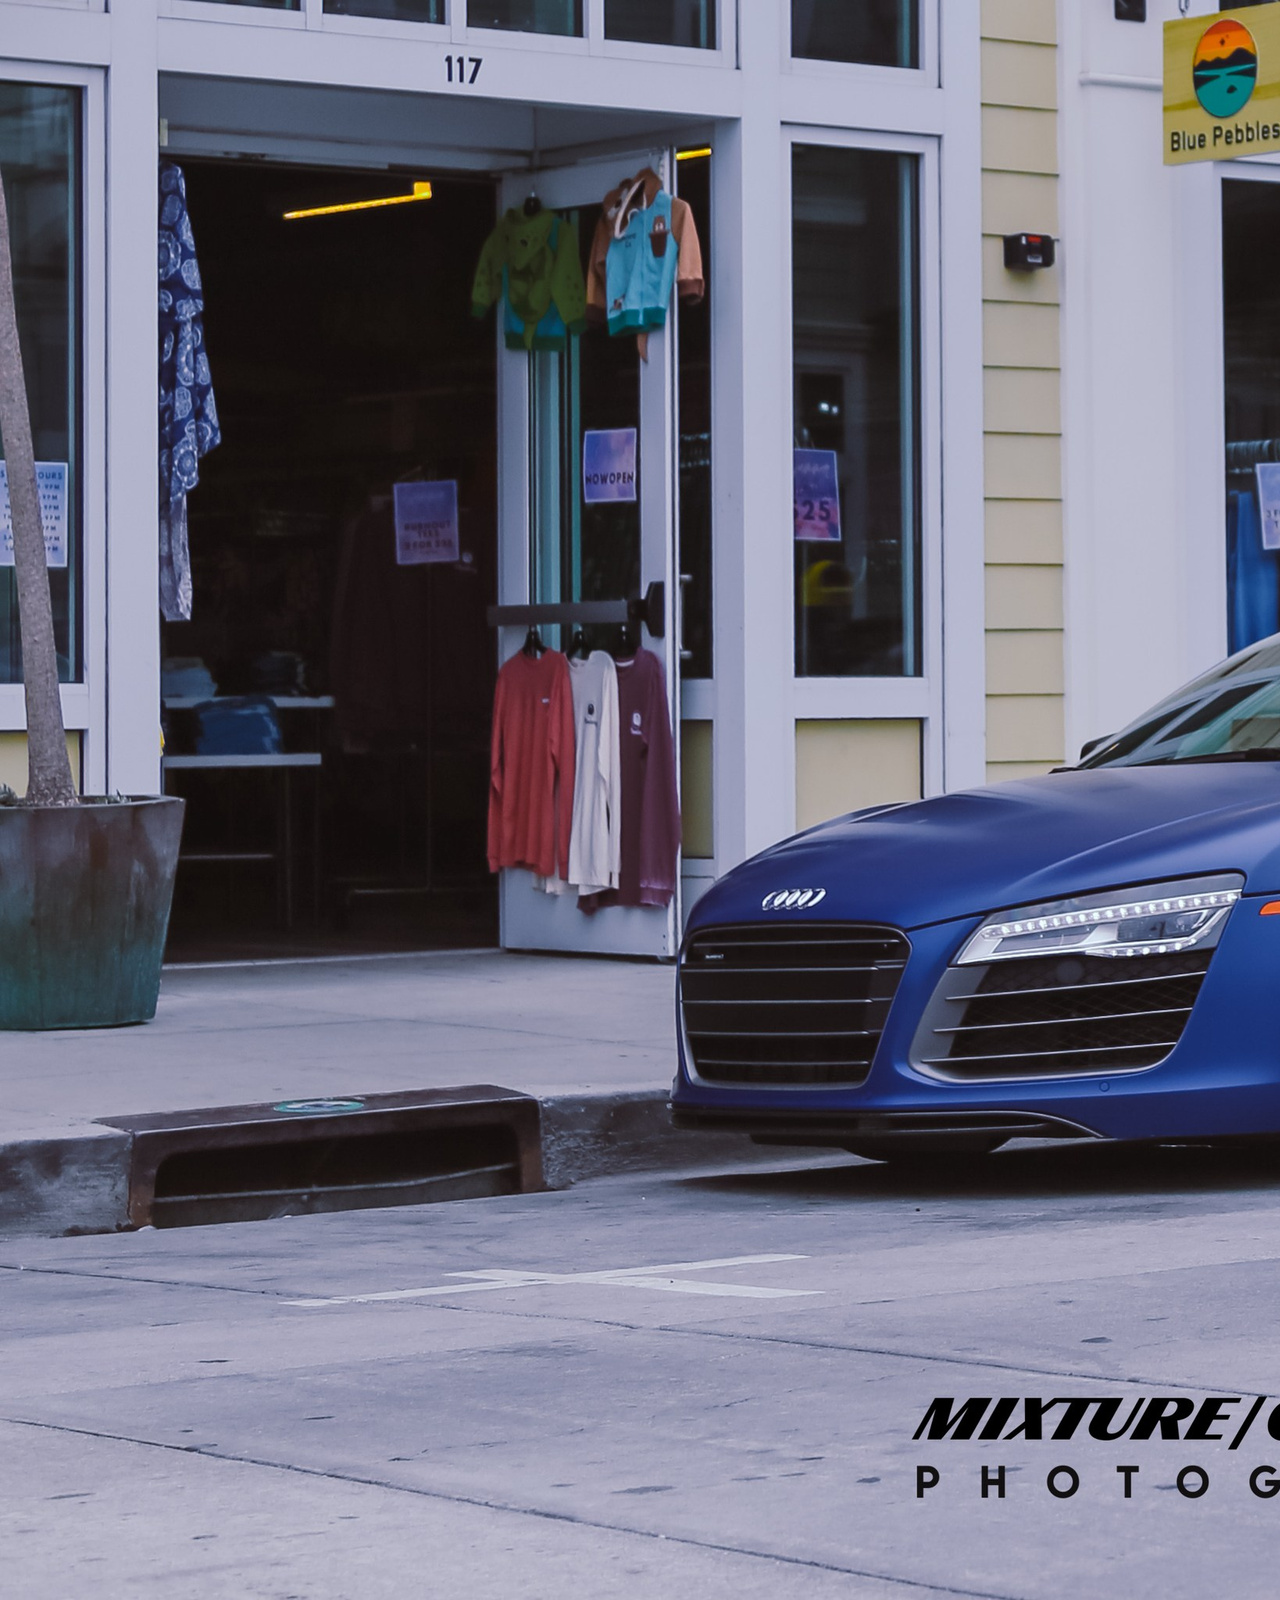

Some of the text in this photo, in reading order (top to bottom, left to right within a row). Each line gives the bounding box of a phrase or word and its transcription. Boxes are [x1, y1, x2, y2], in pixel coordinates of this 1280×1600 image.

[445, 55, 483, 84] 117
[1171, 120, 1280, 152] Blue Pebbles
[38, 471, 63, 480] OURS
